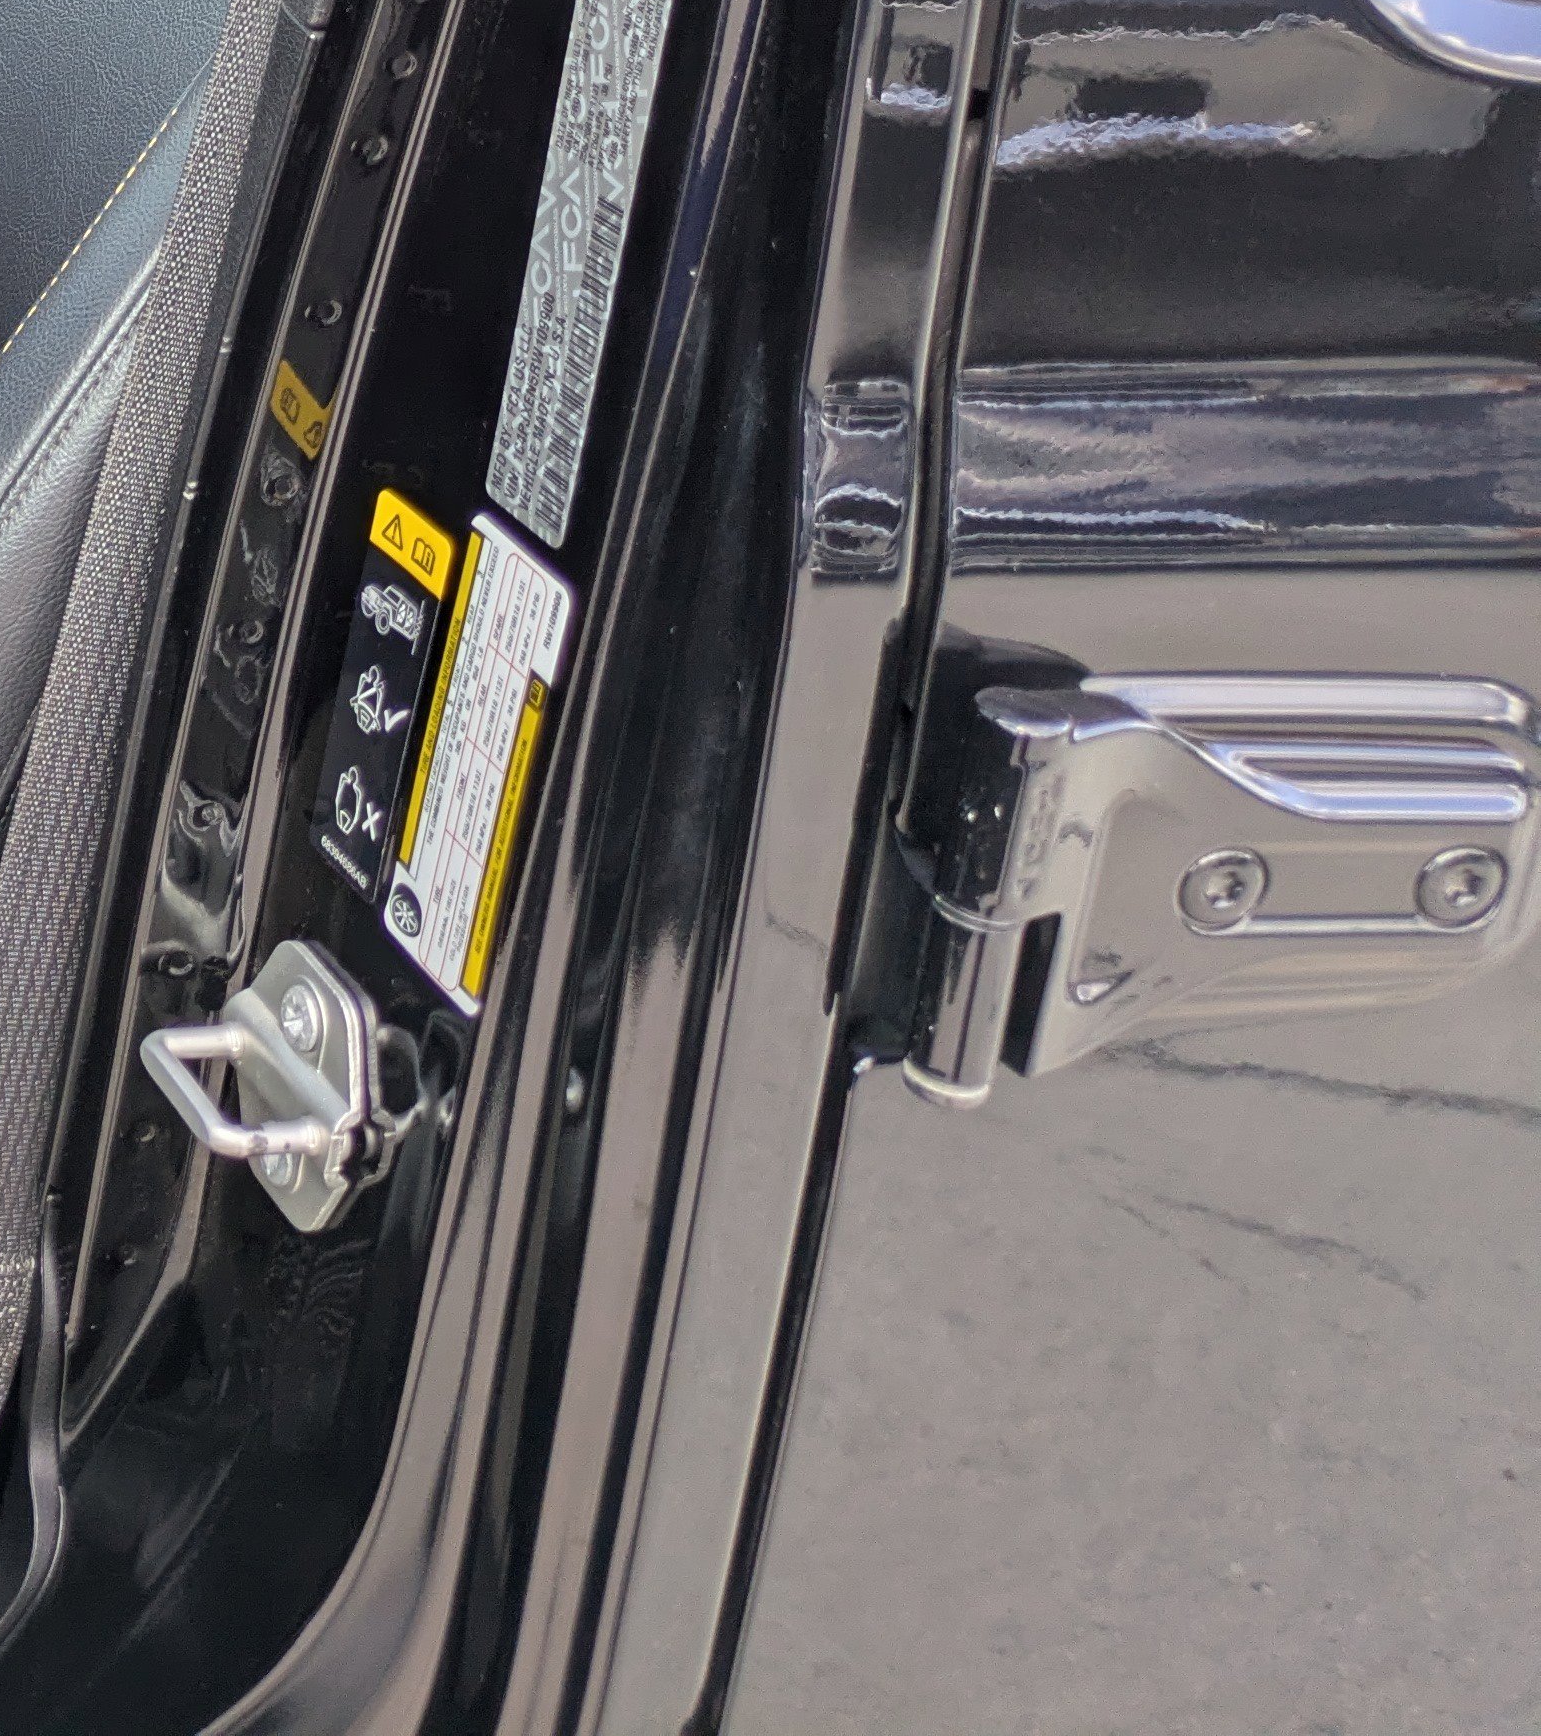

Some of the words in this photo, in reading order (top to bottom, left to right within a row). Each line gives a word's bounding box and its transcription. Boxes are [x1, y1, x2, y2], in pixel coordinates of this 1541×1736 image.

[516, 321, 533, 355] LLC
[511, 354, 527, 382] US
[504, 381, 522, 418] FCA
[517, 442, 541, 513] VEHICLE
[531, 390, 551, 443] MADE
[490, 449, 508, 492] MFD
